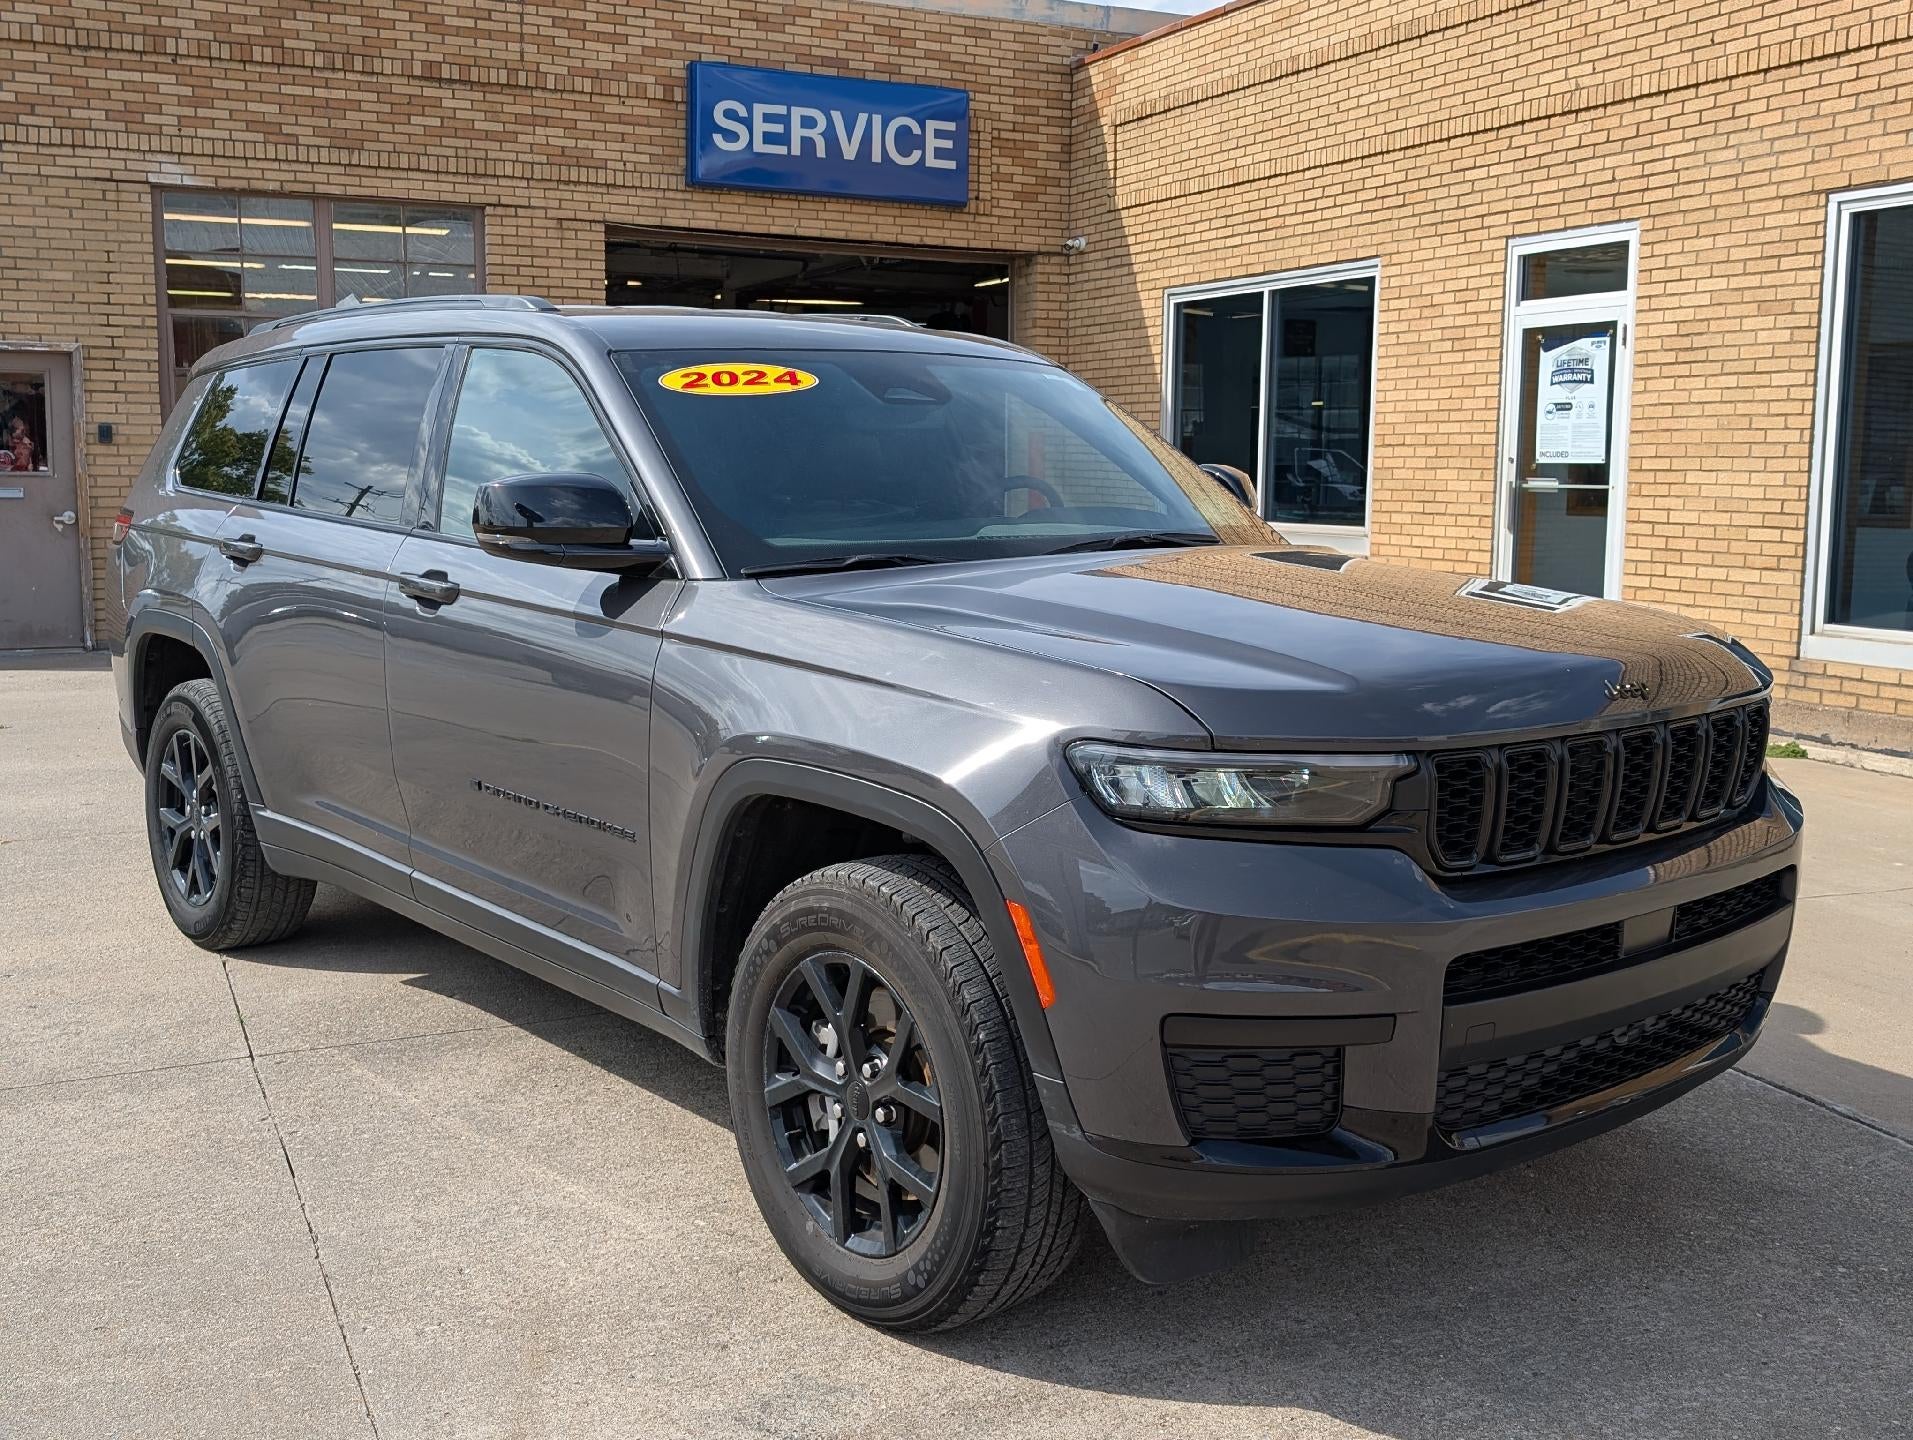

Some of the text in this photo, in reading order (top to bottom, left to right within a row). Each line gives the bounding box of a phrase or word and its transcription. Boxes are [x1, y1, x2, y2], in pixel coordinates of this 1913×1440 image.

[712, 100, 957, 170] SERVICE
[1556, 357, 1590, 368] LIFETIME
[680, 369, 802, 389] 2024
[1552, 373, 1592, 384] WARRANTY
[1539, 450, 1569, 459] INCLUDED
[483, 782, 638, 844] GRAND CHEROKEE
